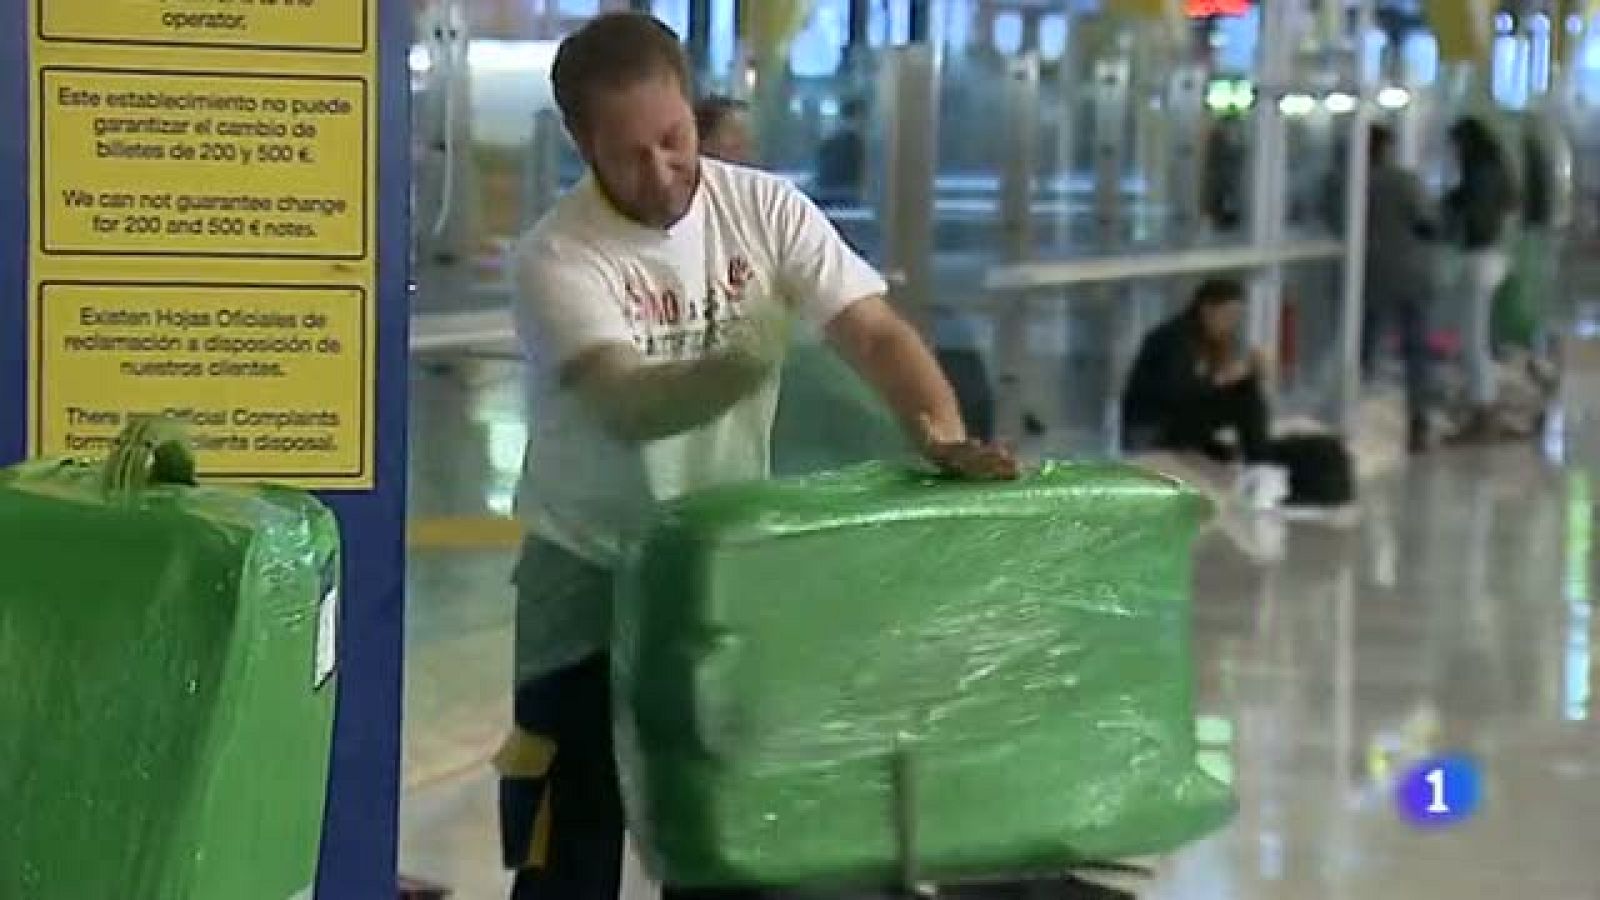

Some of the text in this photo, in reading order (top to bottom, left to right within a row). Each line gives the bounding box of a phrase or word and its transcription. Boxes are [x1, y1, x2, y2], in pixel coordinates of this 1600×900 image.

[58, 87, 351, 120] Este establecimiento no puede
[94, 117, 316, 138] garantizar el cambio de
[97, 141, 164, 158] billetes
[170, 142, 195, 160] de
[200, 143, 236, 160] 200
[240, 149, 251, 164] y
[257, 144, 293, 162] 500
[62, 190, 346, 215] We can not guarantee change
[93, 217, 120, 233] for
[125, 217, 161, 234] 200
[166, 218, 203, 235] and
[207, 219, 244, 236] 500
[264, 221, 318, 238] notes.
[80, 307, 327, 329] Existen Hojas Oficiales de
[188, 339, 200, 352] a
[317, 340, 342, 353] de
[120, 361, 286, 377] nuestros clientes.
[66, 408, 121, 425] There
[232, 408, 341, 429] Complaints
[254, 435, 338, 453] disposal.
